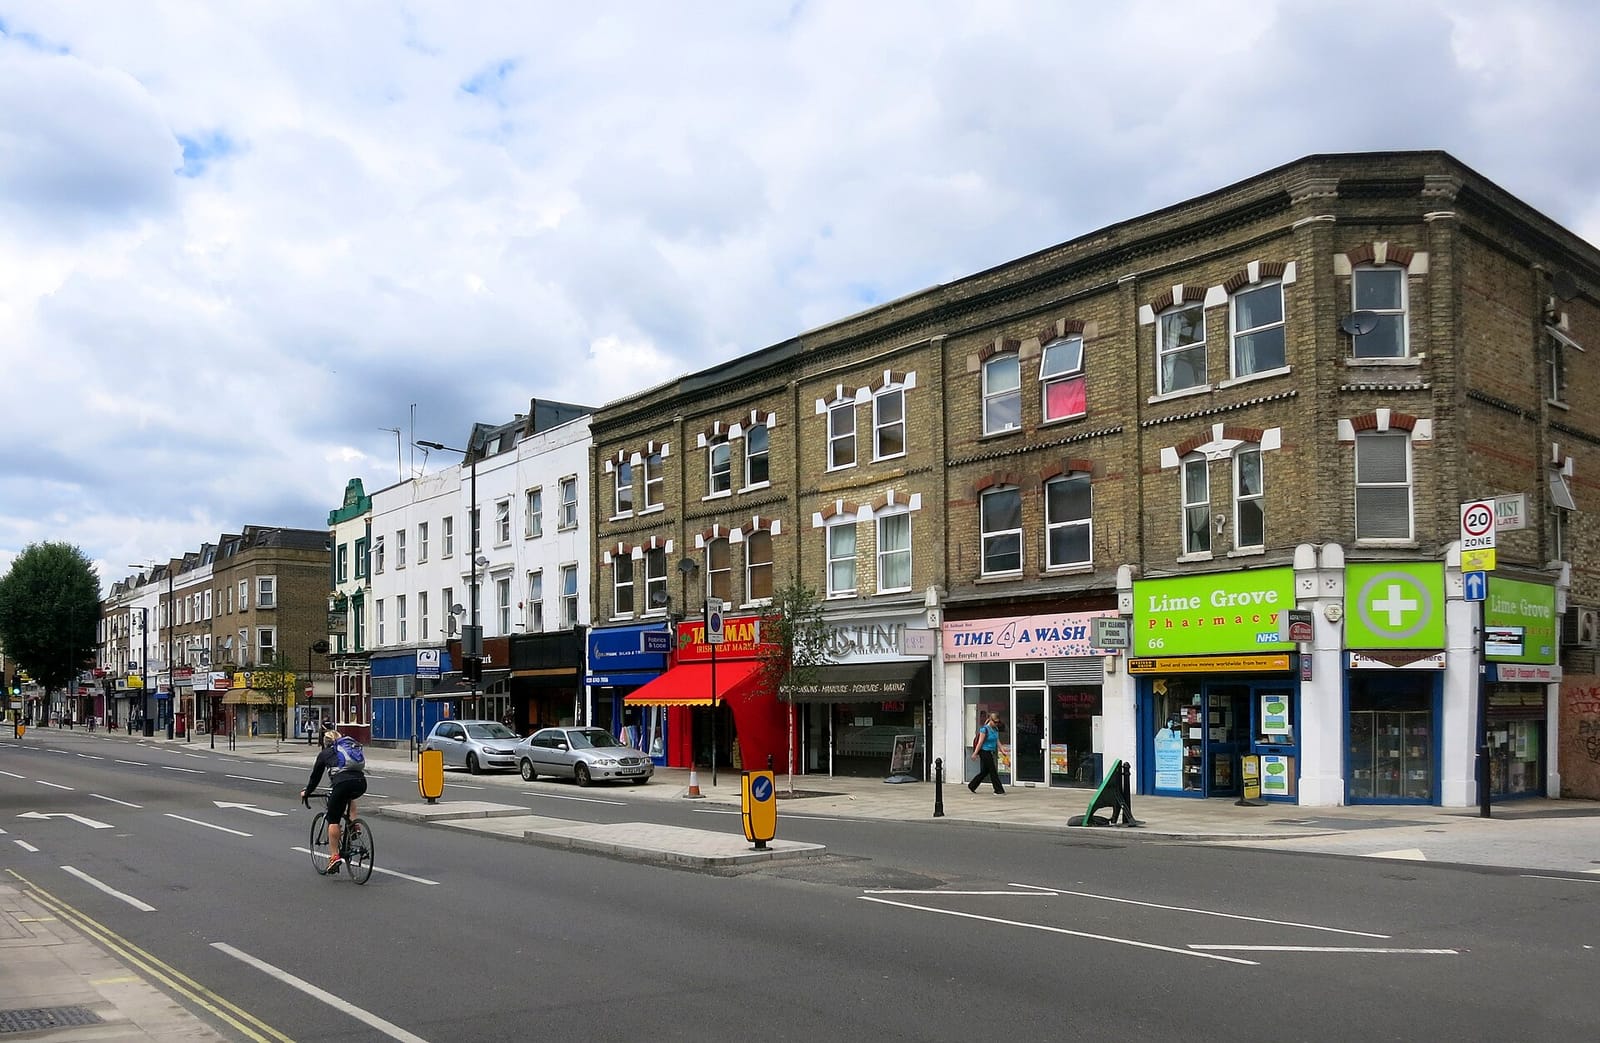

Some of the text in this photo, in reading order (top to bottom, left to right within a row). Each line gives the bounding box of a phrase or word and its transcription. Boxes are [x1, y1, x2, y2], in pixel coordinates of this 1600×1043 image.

[1468, 512, 1488, 527] 20
[1497, 517, 1519, 526] LATE
[1464, 537, 1491, 547] ZONE
[1149, 590, 1278, 612] Lime Grove
[1491, 595, 1550, 618] Lime Grove
[1149, 613, 1279, 629] Pharmacy
[954, 621, 1087, 649] TIME 4 A WASH
[1257, 633, 1279, 643] NHS
[1148, 638, 1165, 648] 66
[697, 645, 712, 653] IRISH
[1353, 653, 1443, 663] Cheques cashed here
